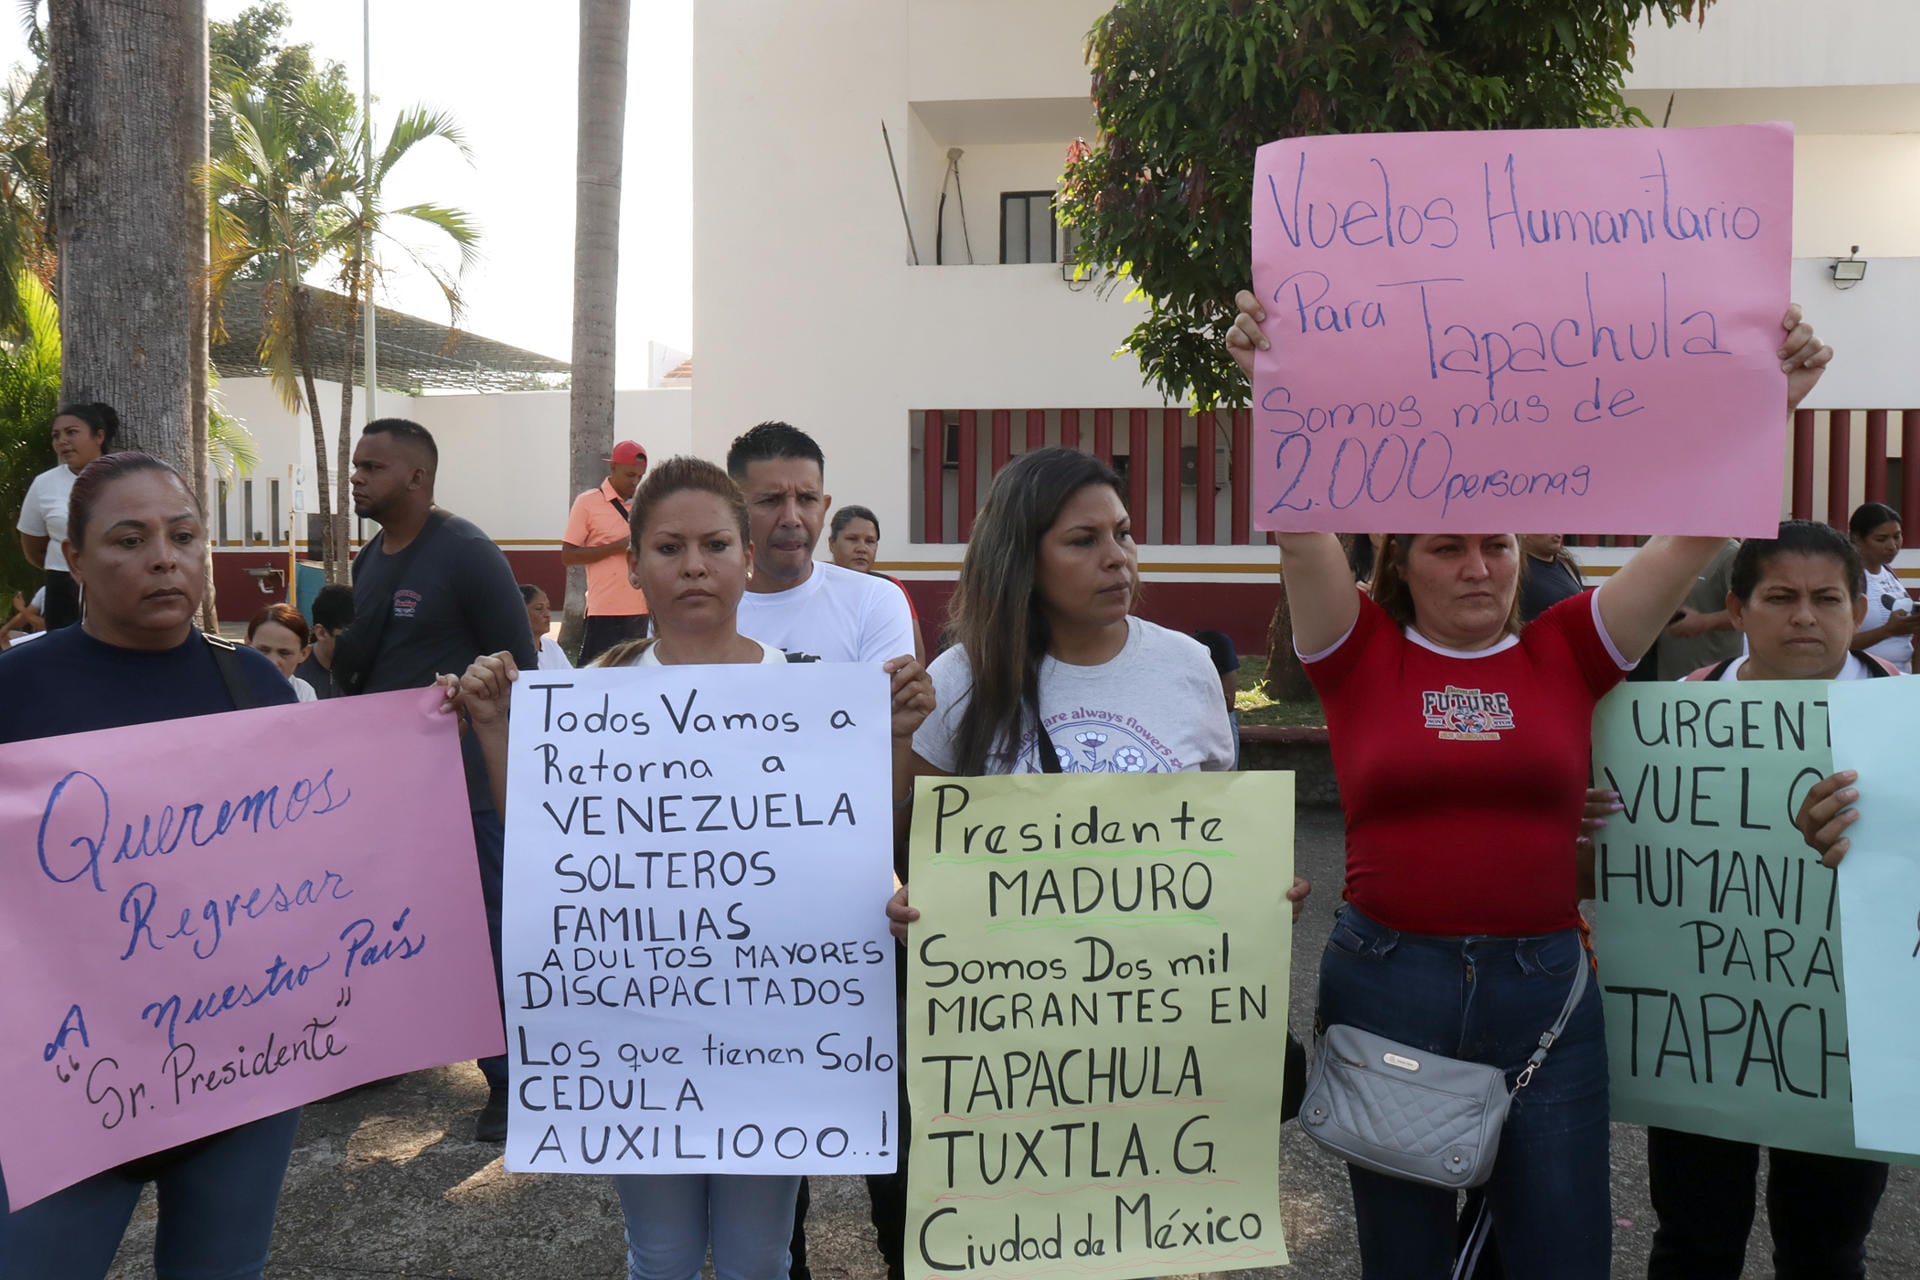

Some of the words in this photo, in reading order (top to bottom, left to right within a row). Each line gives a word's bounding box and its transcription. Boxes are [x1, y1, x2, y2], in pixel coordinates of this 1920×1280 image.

[1267, 151, 1459, 249] Vuelos
[1484, 149, 1761, 250] Humanitario
[1274, 271, 1385, 334] Para
[1376, 271, 1733, 401] Tapachula
[1261, 386, 1422, 435] Somos
[1453, 396, 1550, 429] mas
[1573, 376, 1645, 423] de
[1267, 430, 1453, 514] 2.000
[529, 683, 650, 736] Todos
[660, 688, 800, 734] Vamos
[830, 709, 857, 730] a
[1424, 692, 1511, 715] FUTURE
[1043, 712, 1068, 727] are
[1071, 707, 1123, 722] always
[1126, 717, 1172, 756] flowers
[533, 743, 713, 785] Retorna
[761, 755, 786, 773] a
[37, 769, 350, 892] Queremos
[542, 793, 856, 835] VENEZUELA
[931, 784, 1224, 854] Presidente
[554, 850, 776, 894] SOLTEROS
[989, 862, 1213, 917] MADURO
[120, 870, 353, 960] Regresar
[554, 902, 751, 945] FAMILIAS
[541, 945, 712, 973] ADULTOS
[735, 941, 884, 969] MAYORES
[919, 933, 1067, 988] Somos
[1074, 936, 1153, 983] Dos
[1168, 932, 1230, 975] mil
[1680, 920, 1839, 993] PARA
[43, 1004, 89, 1062] A
[340, 907, 426, 977] País
[517, 971, 865, 1010] DISCAPACITADOS
[928, 988, 1183, 1036] MIGRANTES
[1211, 984, 1267, 1024] EN
[617, 1041, 684, 1073] que
[701, 1034, 804, 1067] tienen
[815, 1032, 894, 1073] Solo
[921, 1045, 1203, 1114] TAPACHULA
[518, 1075, 705, 1112] CEDULA
[919, 1207, 1062, 1272] Ciudad
[1073, 1213, 1106, 1257] de
[1115, 1193, 1263, 1254] México
